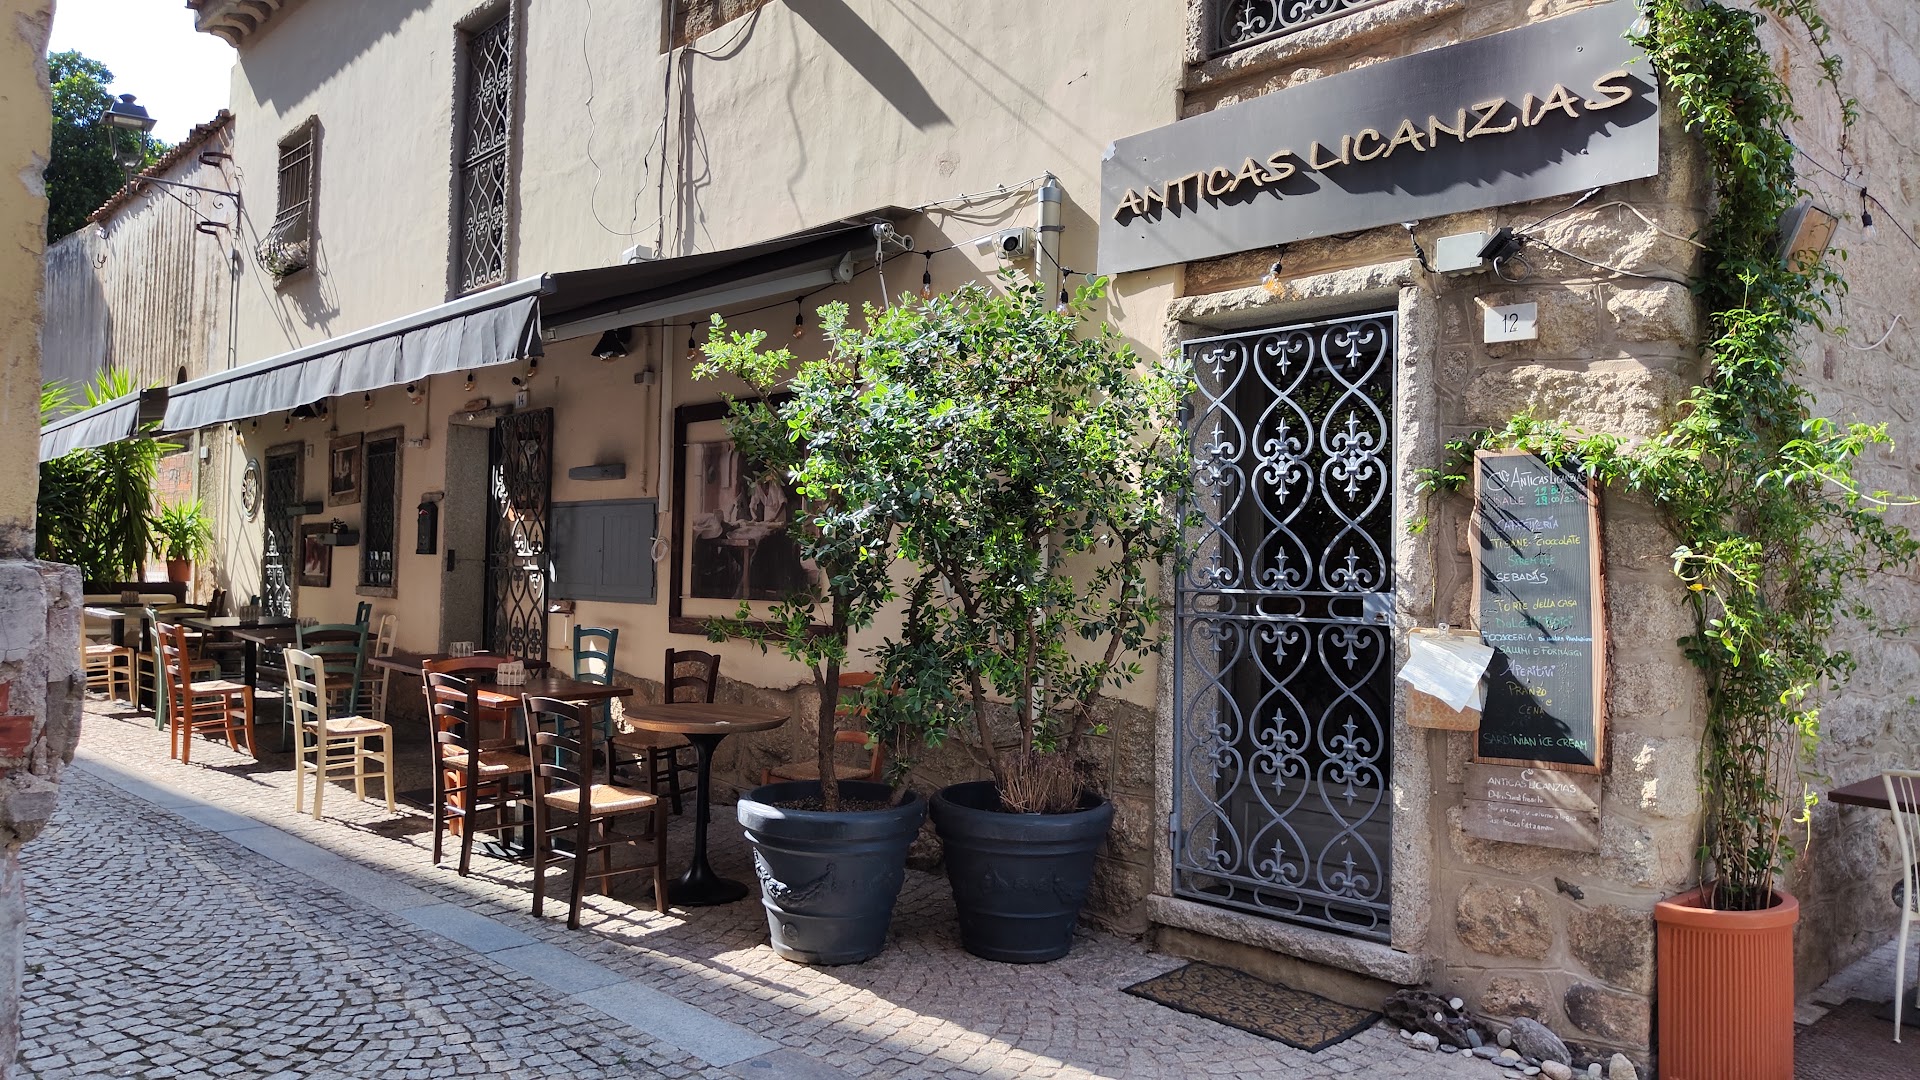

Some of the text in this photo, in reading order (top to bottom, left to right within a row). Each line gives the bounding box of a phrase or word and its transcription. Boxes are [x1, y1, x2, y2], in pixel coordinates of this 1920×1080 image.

[1112, 70, 1635, 220] ANTICAS LICANZIAS
[1503, 313, 1519, 333] 12
[1487, 776, 1577, 794] ANTICAS LICANZIAS
